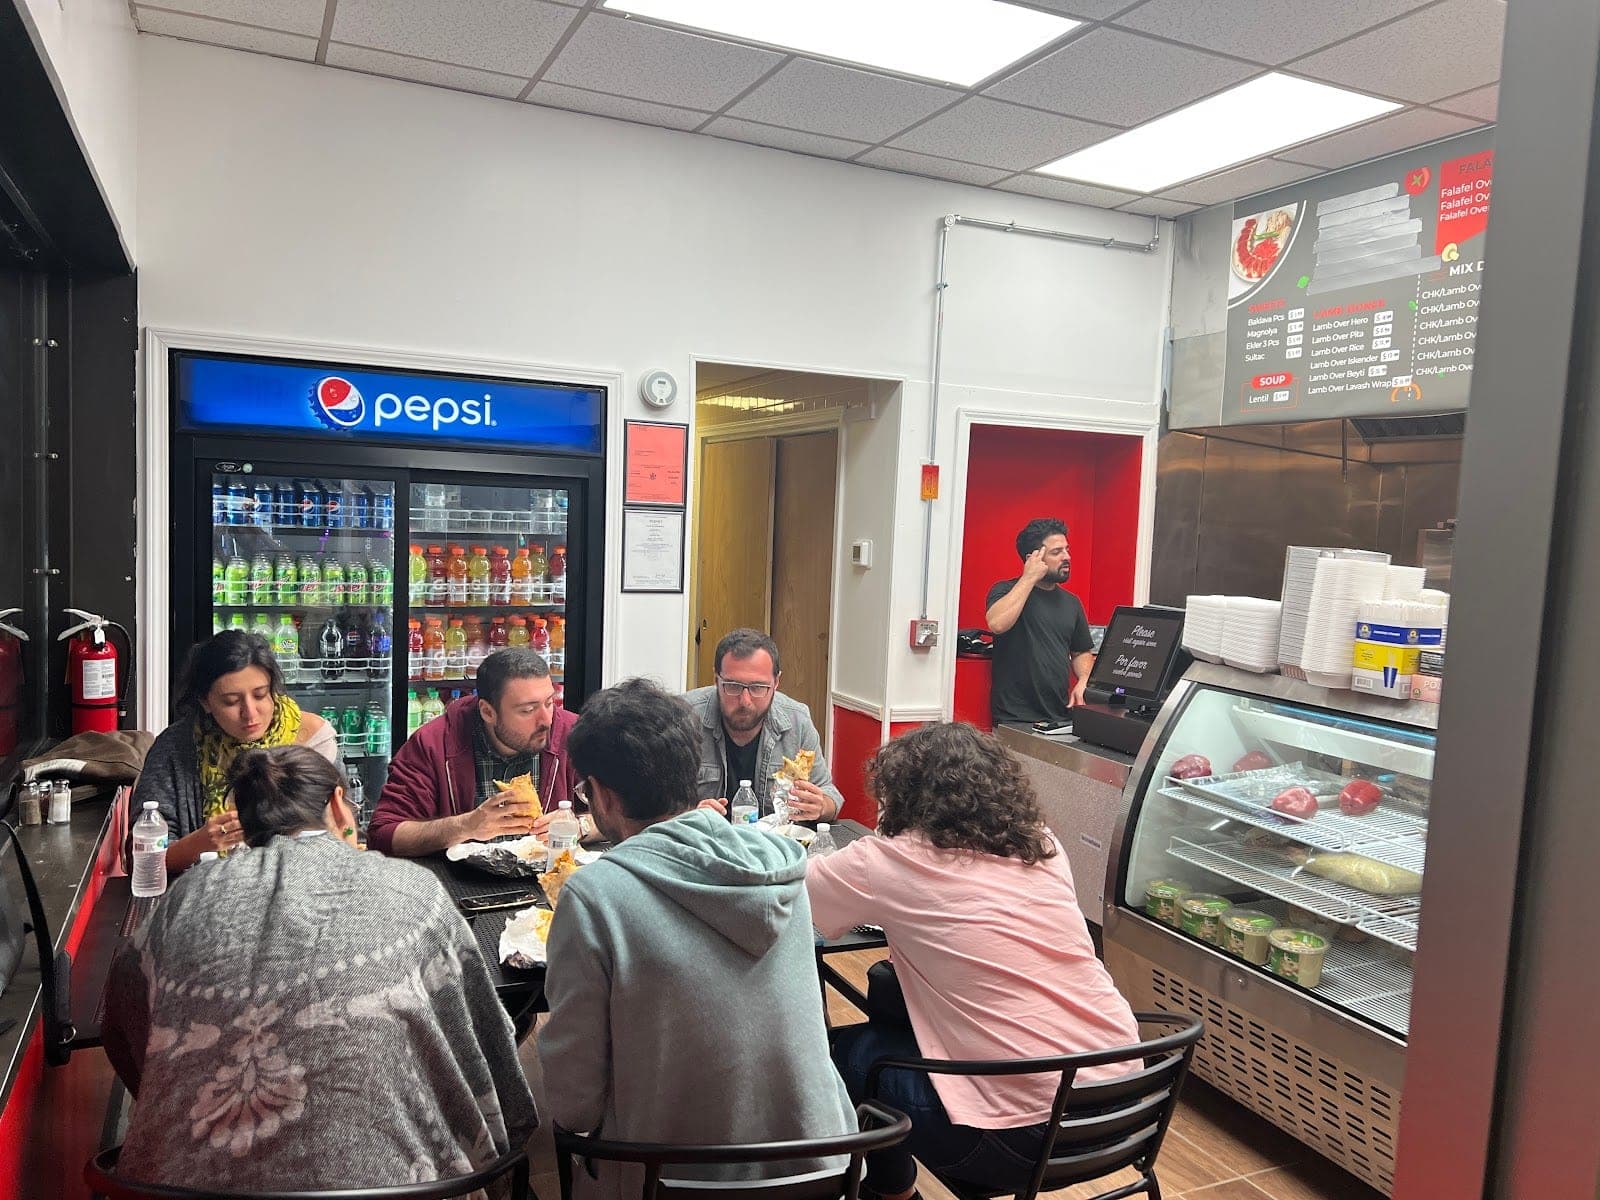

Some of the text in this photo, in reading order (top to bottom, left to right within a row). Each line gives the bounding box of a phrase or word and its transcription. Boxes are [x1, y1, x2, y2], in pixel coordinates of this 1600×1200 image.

[1442, 179, 1491, 198] Falafel Ov
[1440, 195, 1472, 211] Falafel
[1440, 208, 1468, 221] Falafel
[1449, 261, 1474, 277] MIX
[1422, 284, 1481, 299] CHK/Lamb Ov
[1420, 300, 1480, 314] CHK/Lamb Ov
[1312, 322, 1333, 332] Lamb
[1333, 319, 1350, 328] Over
[1350, 317, 1369, 326] Hero
[1420, 317, 1464, 330] CHK/Lamb
[1262, 340, 1267, 348] 3
[1312, 334, 1331, 344] Lamb
[1332, 332, 1349, 341] Over
[1350, 330, 1364, 338] Pita
[1418, 332, 1462, 345] CHK/Lamb
[1311, 347, 1331, 357] Lamb
[1331, 345, 1348, 354] Over
[1349, 343, 1365, 352] Rice
[1417, 348, 1461, 360] CHK/Lamb
[1310, 360, 1330, 370] Lamb
[1330, 358, 1347, 366] Over
[1347, 354, 1378, 365] Iskander
[1309, 373, 1328, 382] Lamb
[1329, 370, 1346, 379] Over
[1346, 368, 1365, 379] Beyti
[1416, 365, 1457, 376] CHK/Lamb
[1259, 374, 1286, 386] SOUP
[1308, 385, 1328, 395] Lamb
[1328, 384, 1344, 392] Over
[1346, 382, 1370, 391] Lavash
[1371, 380, 1392, 390] Wrap
[1248, 394, 1270, 404] Lentil
[375, 393, 491, 431] pepsi
[1131, 624, 1156, 638] Please
[1114, 654, 1148, 671] Por favor
